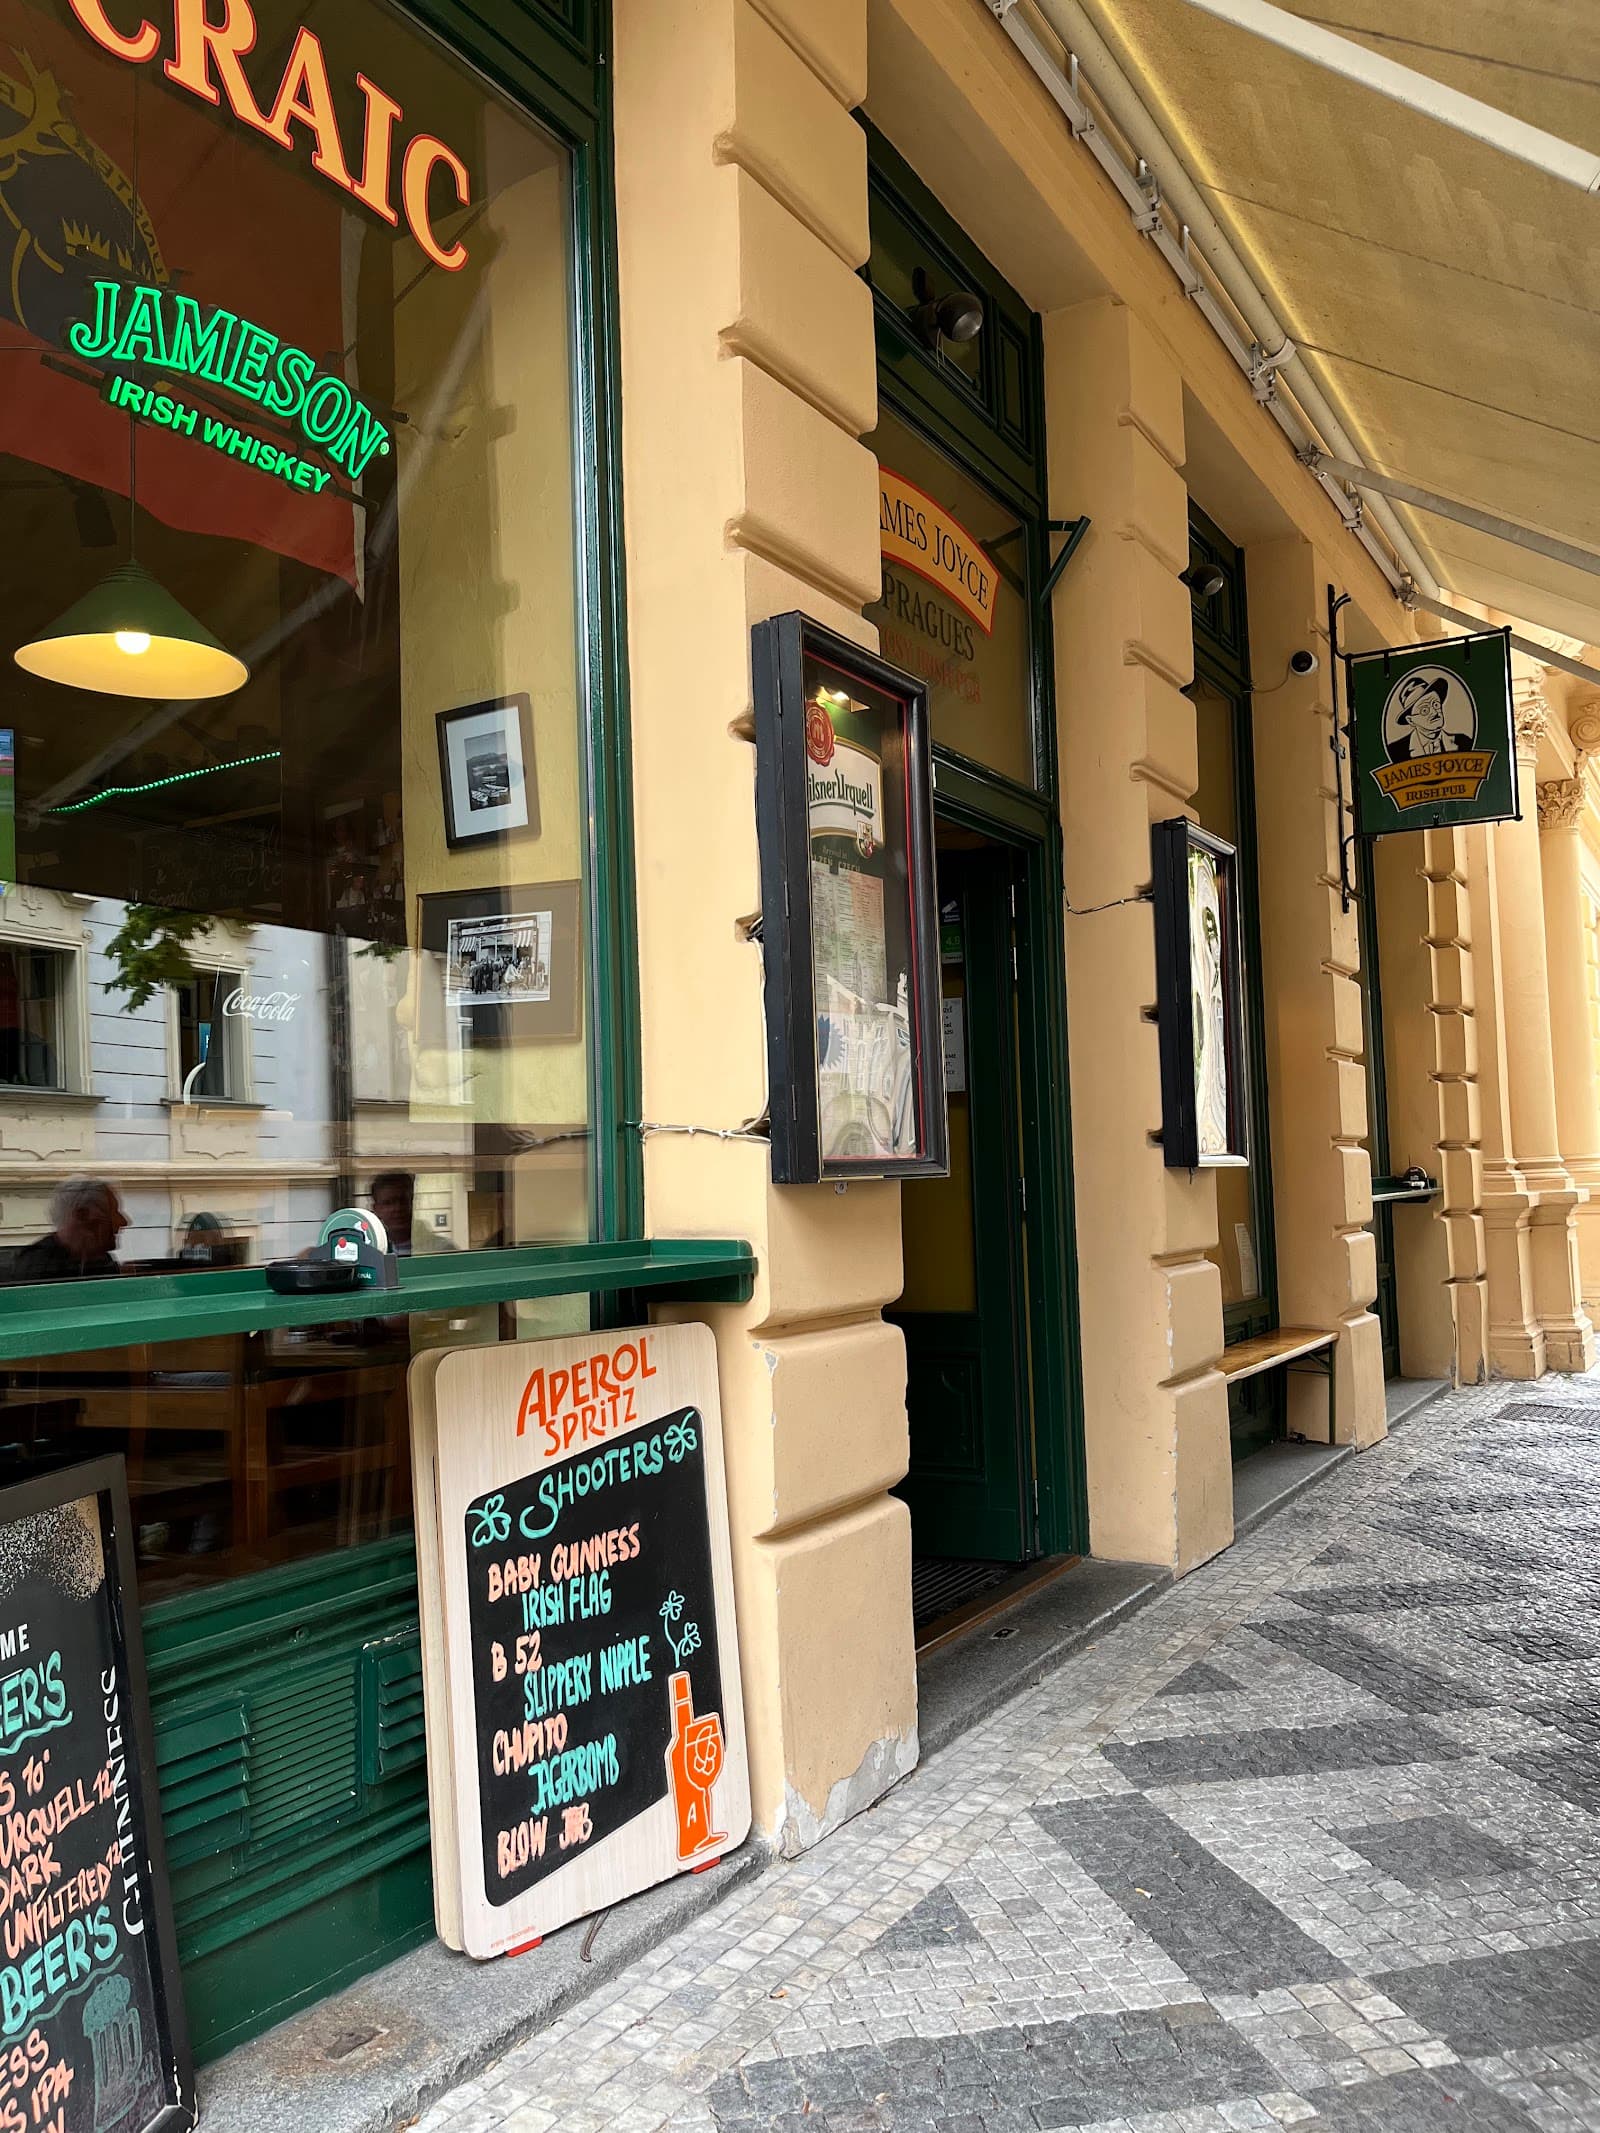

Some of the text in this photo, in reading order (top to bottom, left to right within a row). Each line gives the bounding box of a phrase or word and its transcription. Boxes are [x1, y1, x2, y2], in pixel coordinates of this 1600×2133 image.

[70, 281, 389, 479] JAMESON
[109, 375, 331, 493] IRISH WHISKEY
[932, 525, 988, 610] JOYCE
[835, 768, 873, 816] Urquell
[1383, 757, 1484, 789] JAMES JOYCE
[1405, 784, 1466, 801] IRISH PUB
[222, 987, 301, 1022] Coca-Cola
[516, 1337, 657, 1437] APEROL
[519, 1434, 665, 1539] SHOOTERS
[488, 1522, 641, 1602] BABY GUINNESS
[522, 1569, 612, 1632] IRISH FLAG
[0, 1623, 30, 1661] ME
[492, 1630, 543, 1682] B 52
[523, 1634, 653, 1721] SLIPPERY NIPPLE
[0, 1650, 66, 1736] ER'S
[493, 1713, 568, 1776] CHUPITO
[528, 1732, 620, 1815] JAGERBOMB
[0, 1778, 95, 1868] URQUELL
[497, 1816, 549, 1879] BLOW
[0, 1842, 61, 1917] DARK
[5, 1863, 112, 1960] UNFILTERED
[1, 1904, 118, 2035] BEER'S
[31, 2058, 75, 2124] IPA
